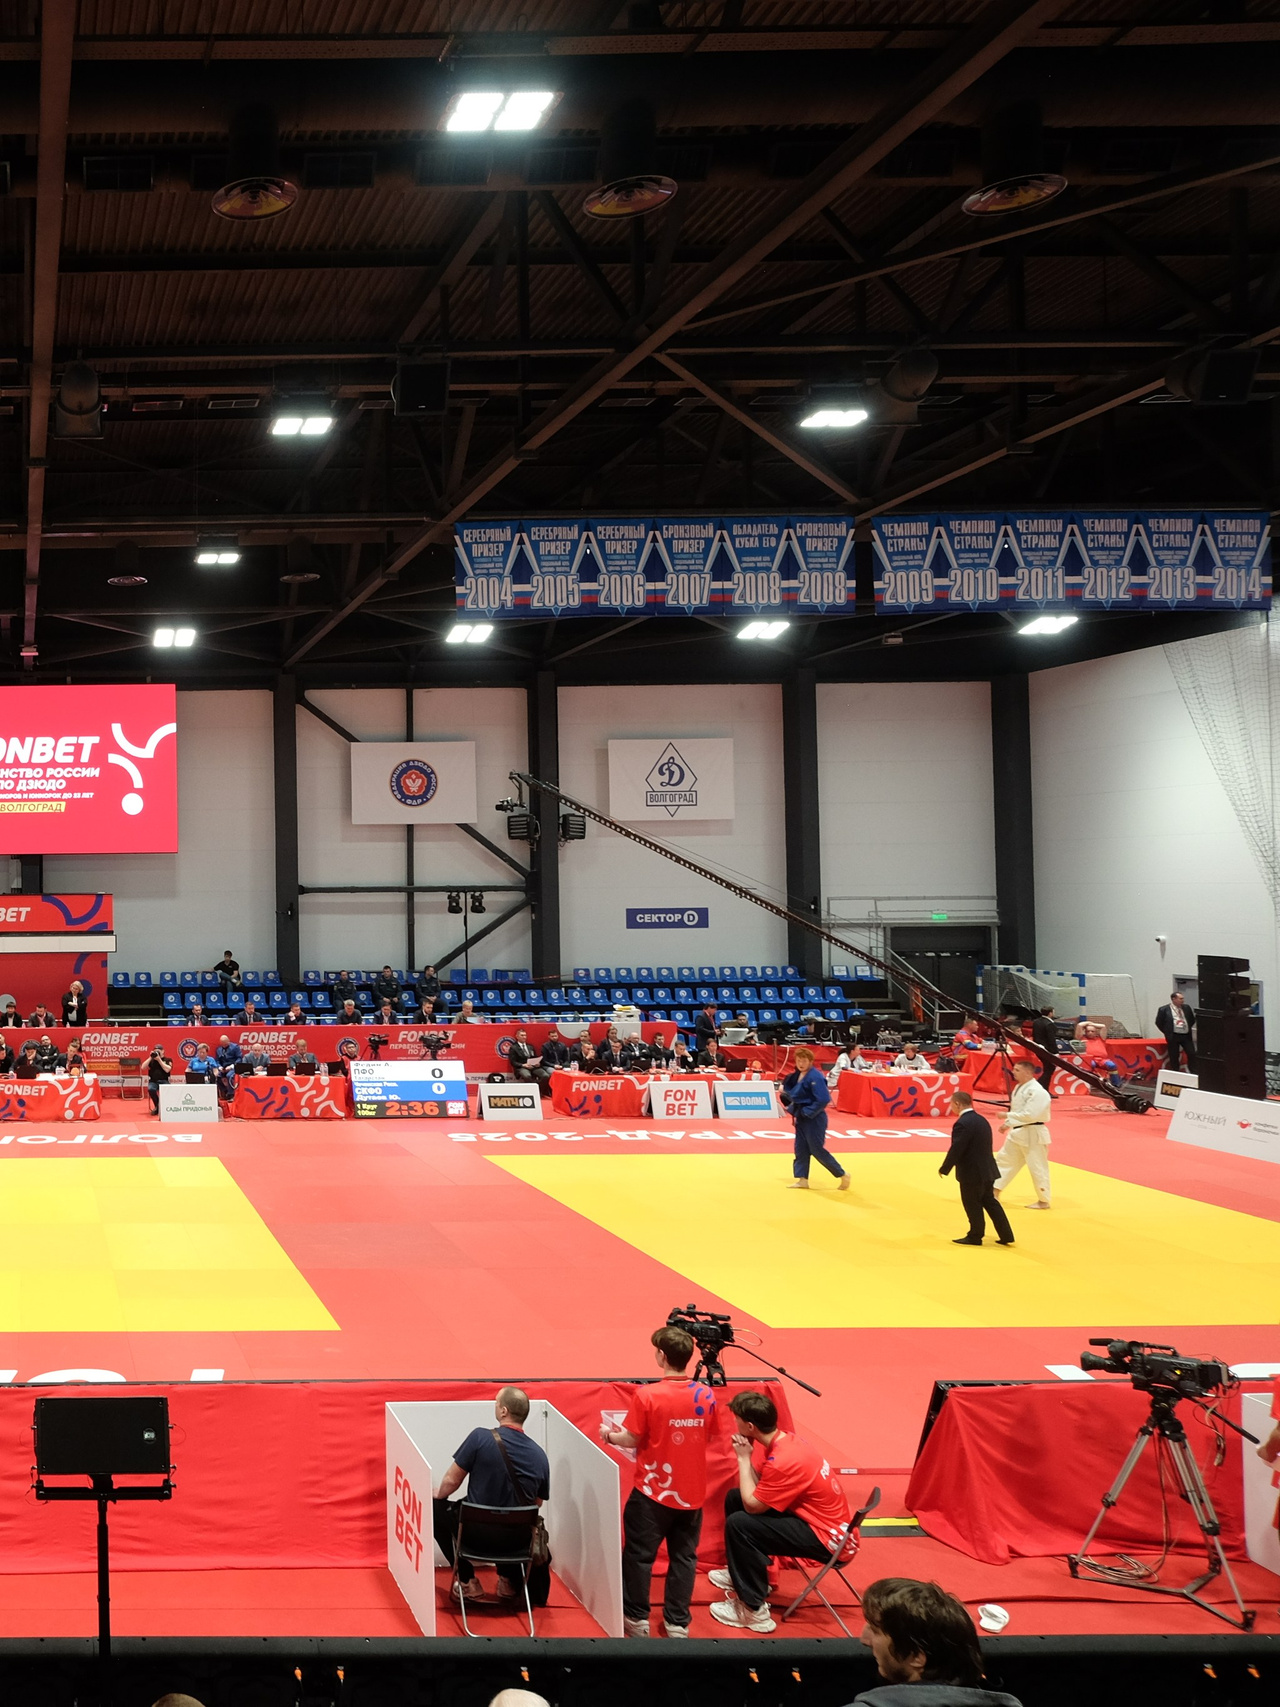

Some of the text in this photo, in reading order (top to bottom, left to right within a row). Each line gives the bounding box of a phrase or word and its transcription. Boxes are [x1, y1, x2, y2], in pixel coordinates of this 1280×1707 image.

[531, 524, 578, 540] СЕРЕБРЯНЫЙ
[597, 523, 645, 539] СЕРЕБРЯНЫЙ
[662, 523, 714, 539] БРОНЗОВЫЙ
[732, 524, 778, 537] ОБЛАДАТЕЛЬ
[796, 522, 847, 537] БРОНЗОВЫЙ
[882, 521, 929, 537] ЧЕМПИОН
[949, 520, 996, 534] ЧЕМПИОН
[1016, 519, 1063, 533] ЧЕМПИОН
[1083, 519, 1128, 532] ЧЕМПИОН
[1148, 519, 1193, 532] ЧЕМПИОН
[1214, 519, 1260, 533] ЧЕМПИОН
[463, 526, 511, 543] СЕРЕБРЯНЫЙ
[1021, 534, 1060, 548] СТРАНЫ
[1087, 534, 1125, 548] СТРАНЫ
[1152, 534, 1190, 548] СТРАНЫ
[1218, 534, 1257, 548] СТРАНЫ
[539, 541, 571, 555] ПРИЗЕР
[605, 540, 637, 554] ПРИЗЕР
[672, 539, 705, 553] ПРИЗЕР
[735, 536, 759, 548] КУБКА
[805, 537, 838, 551] ПРИЗЕР
[887, 537, 927, 552] СТРАНЫ
[954, 536, 993, 550] СТРАНЫ
[472, 543, 505, 557] ПРИЗЕР
[531, 574, 581, 607] 2005
[597, 573, 645, 607] 2006
[666, 572, 712, 605] 2007
[733, 571, 782, 605] 2008
[798, 571, 847, 605] 2008
[883, 569, 934, 604] 2009
[949, 568, 999, 602] 2010
[1016, 567, 1065, 601] 2011
[1083, 567, 1132, 600] 2012
[1148, 567, 1196, 600] 2013
[1214, 567, 1262, 601] 2014
[464, 576, 514, 609] 2004
[46, 767, 100, 778] РОССИИ
[16, 779, 66, 791] ДЗЮДО
[391, 761, 437, 799] ФЕДЕРАЦИЯ ДЗЮДО РОССИИ
[649, 793, 694, 803] ВОЛГОГРАД
[0, 803, 63, 813] ВОЛГОГРАД
[636, 913, 682, 923] СЕКТОР
[81, 1033, 139, 1044] FONBET
[239, 1032, 297, 1043] FONBET
[572, 1079, 625, 1093] FONBET
[664, 1089, 696, 1102] FON
[182, 1105, 212, 1113] ПРИДОНЬЯ
[385, 1102, 439, 1116] 2:36
[665, 1103, 698, 1116] BET
[1184, 1110, 1227, 1126] ЮЖНЫЙ
[447, 1129, 952, 1143] ВОЛОГРАД-2025
[669, 1418, 704, 1428] FONBET
[394, 1465, 422, 1535] FON
[395, 1504, 423, 1574] BET
